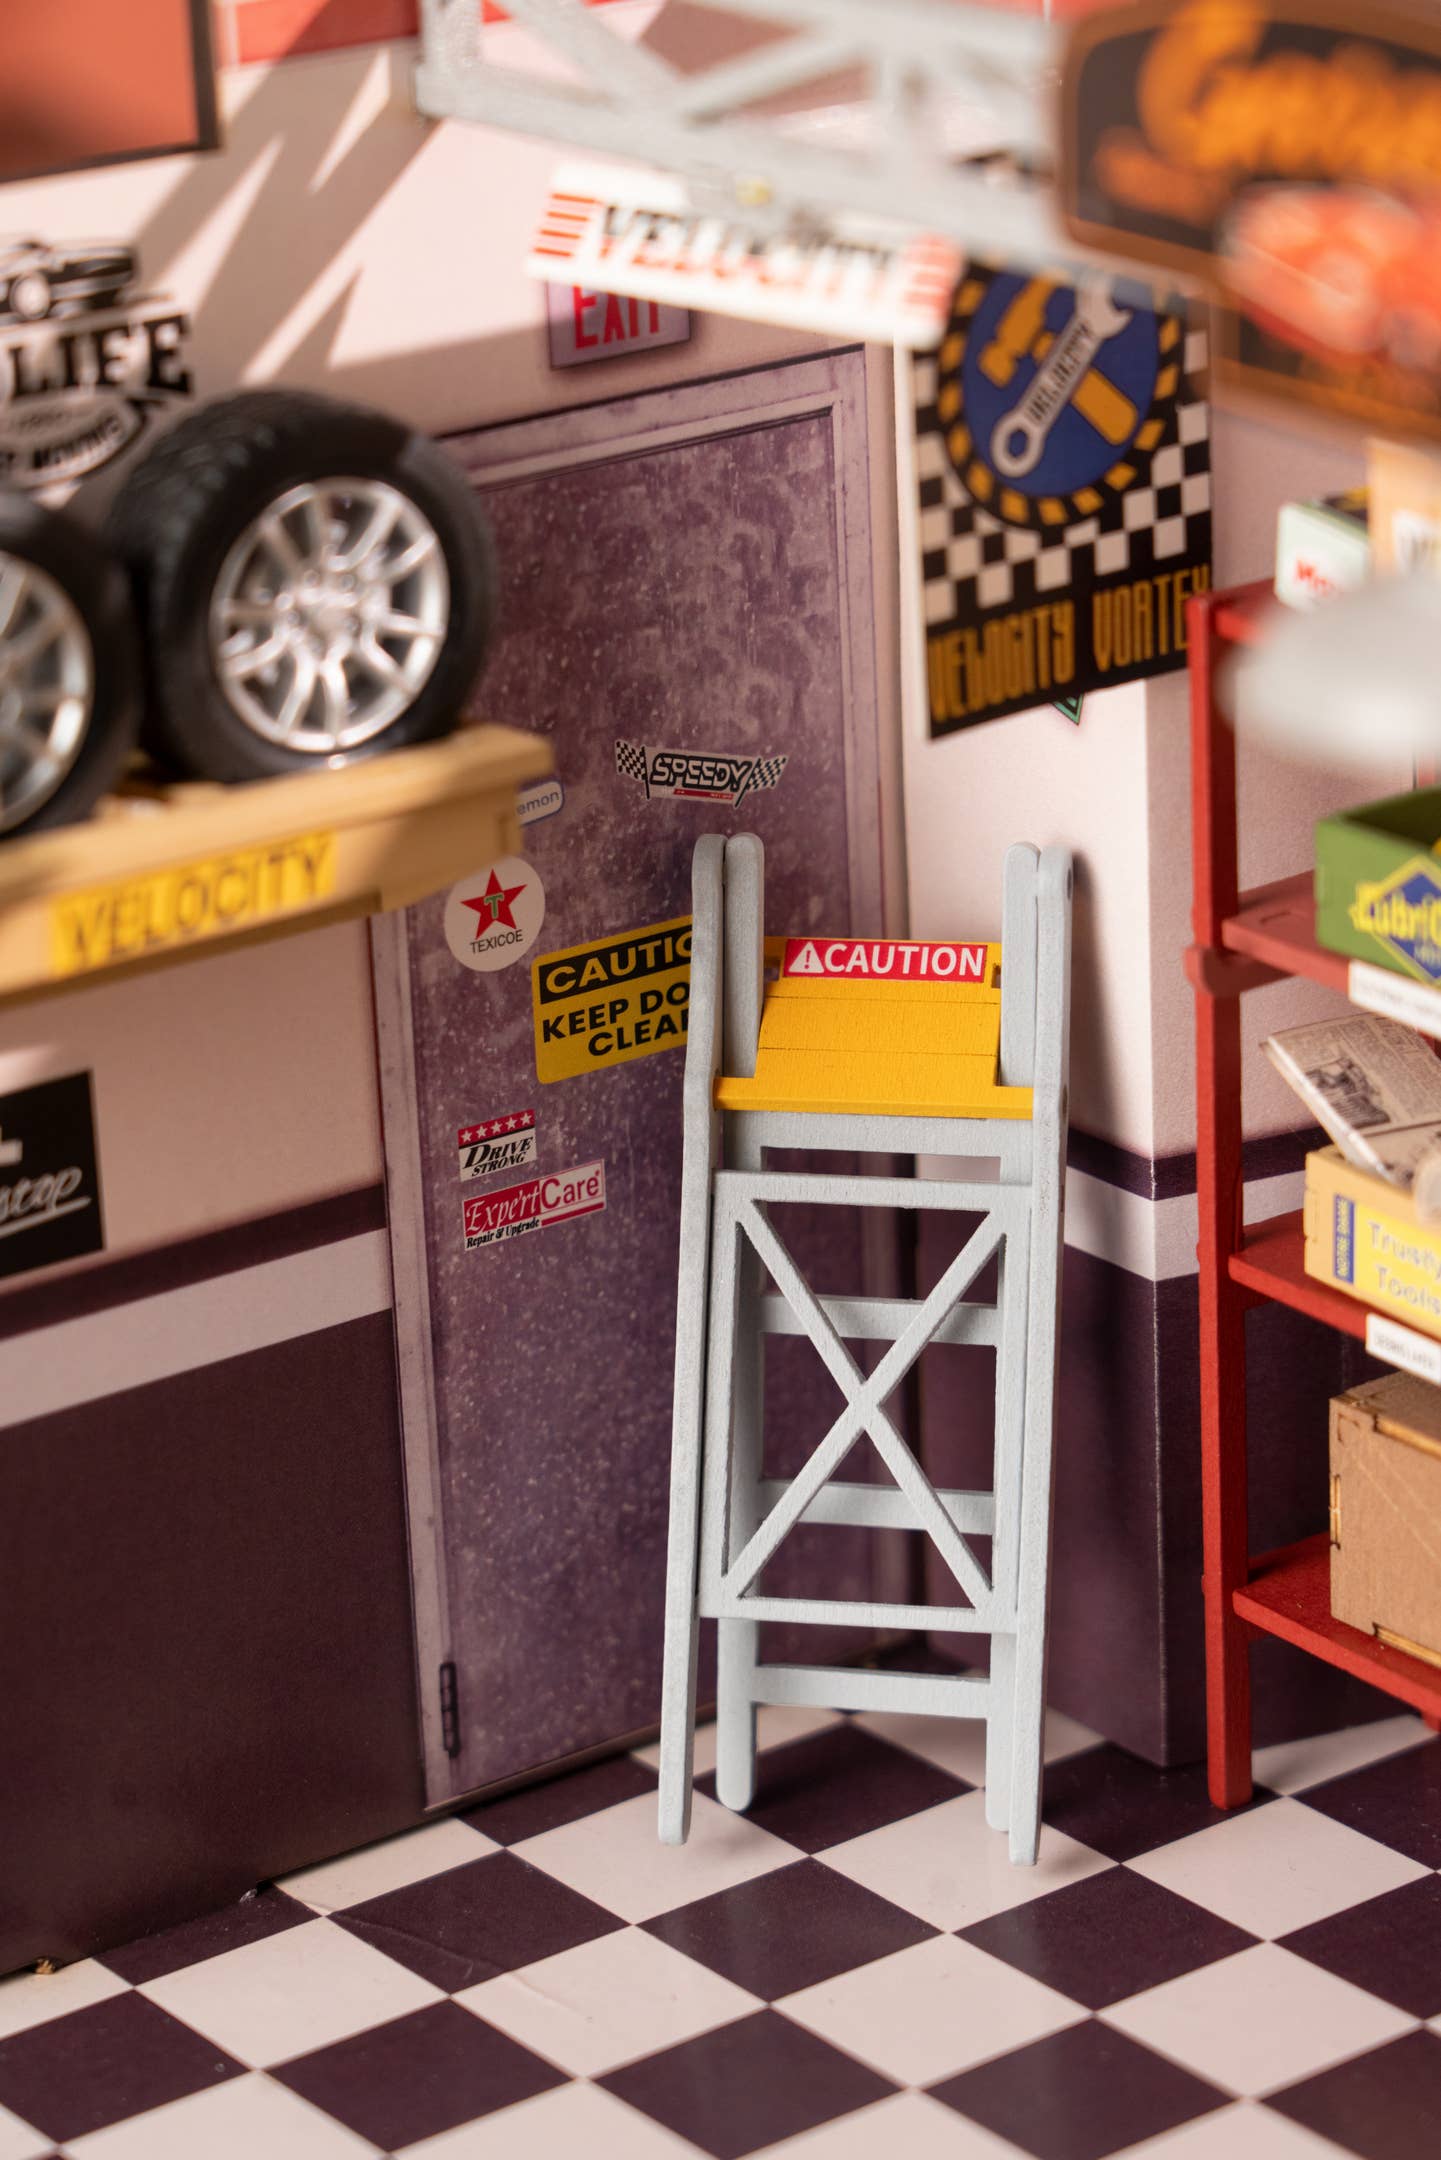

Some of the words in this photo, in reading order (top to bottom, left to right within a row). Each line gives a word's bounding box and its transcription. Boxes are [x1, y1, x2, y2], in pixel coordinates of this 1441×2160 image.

[650, 752, 752, 793] SPEEDY
[68, 836, 335, 962] VELOCITY
[470, 929, 524, 954] TEXICOE
[824, 943, 985, 977] CAUTION
[542, 998, 629, 1044] KEEP
[462, 1136, 534, 1170] DRIVE
[471, 1151, 527, 1177] STRONG
[466, 1231, 495, 1249] Repair
[505, 1217, 541, 1237] Upgrade
